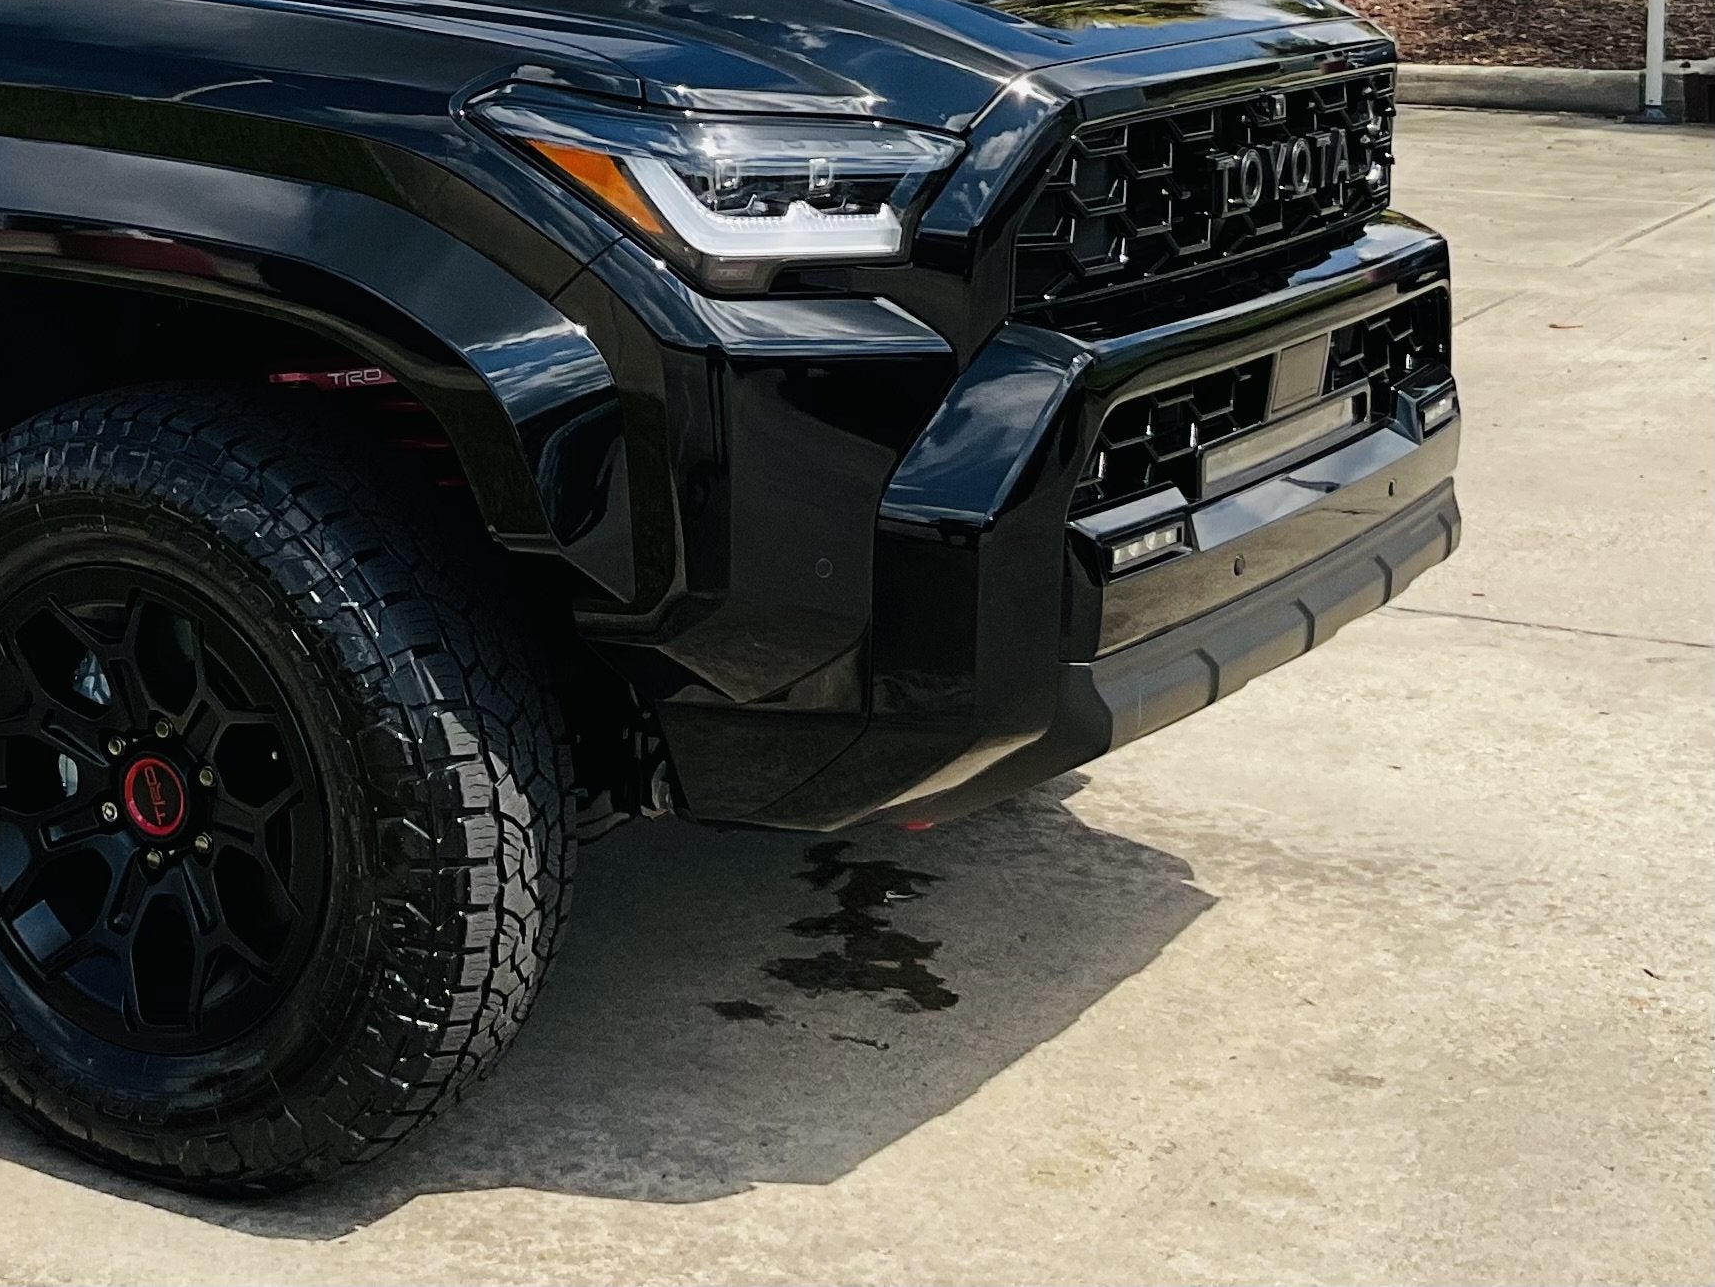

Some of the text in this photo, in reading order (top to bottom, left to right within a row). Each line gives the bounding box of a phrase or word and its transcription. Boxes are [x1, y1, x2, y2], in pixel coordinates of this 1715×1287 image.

[1205, 127, 1352, 213] TOYOTA
[327, 368, 382, 387] TRD
[144, 766, 166, 825] TRD
